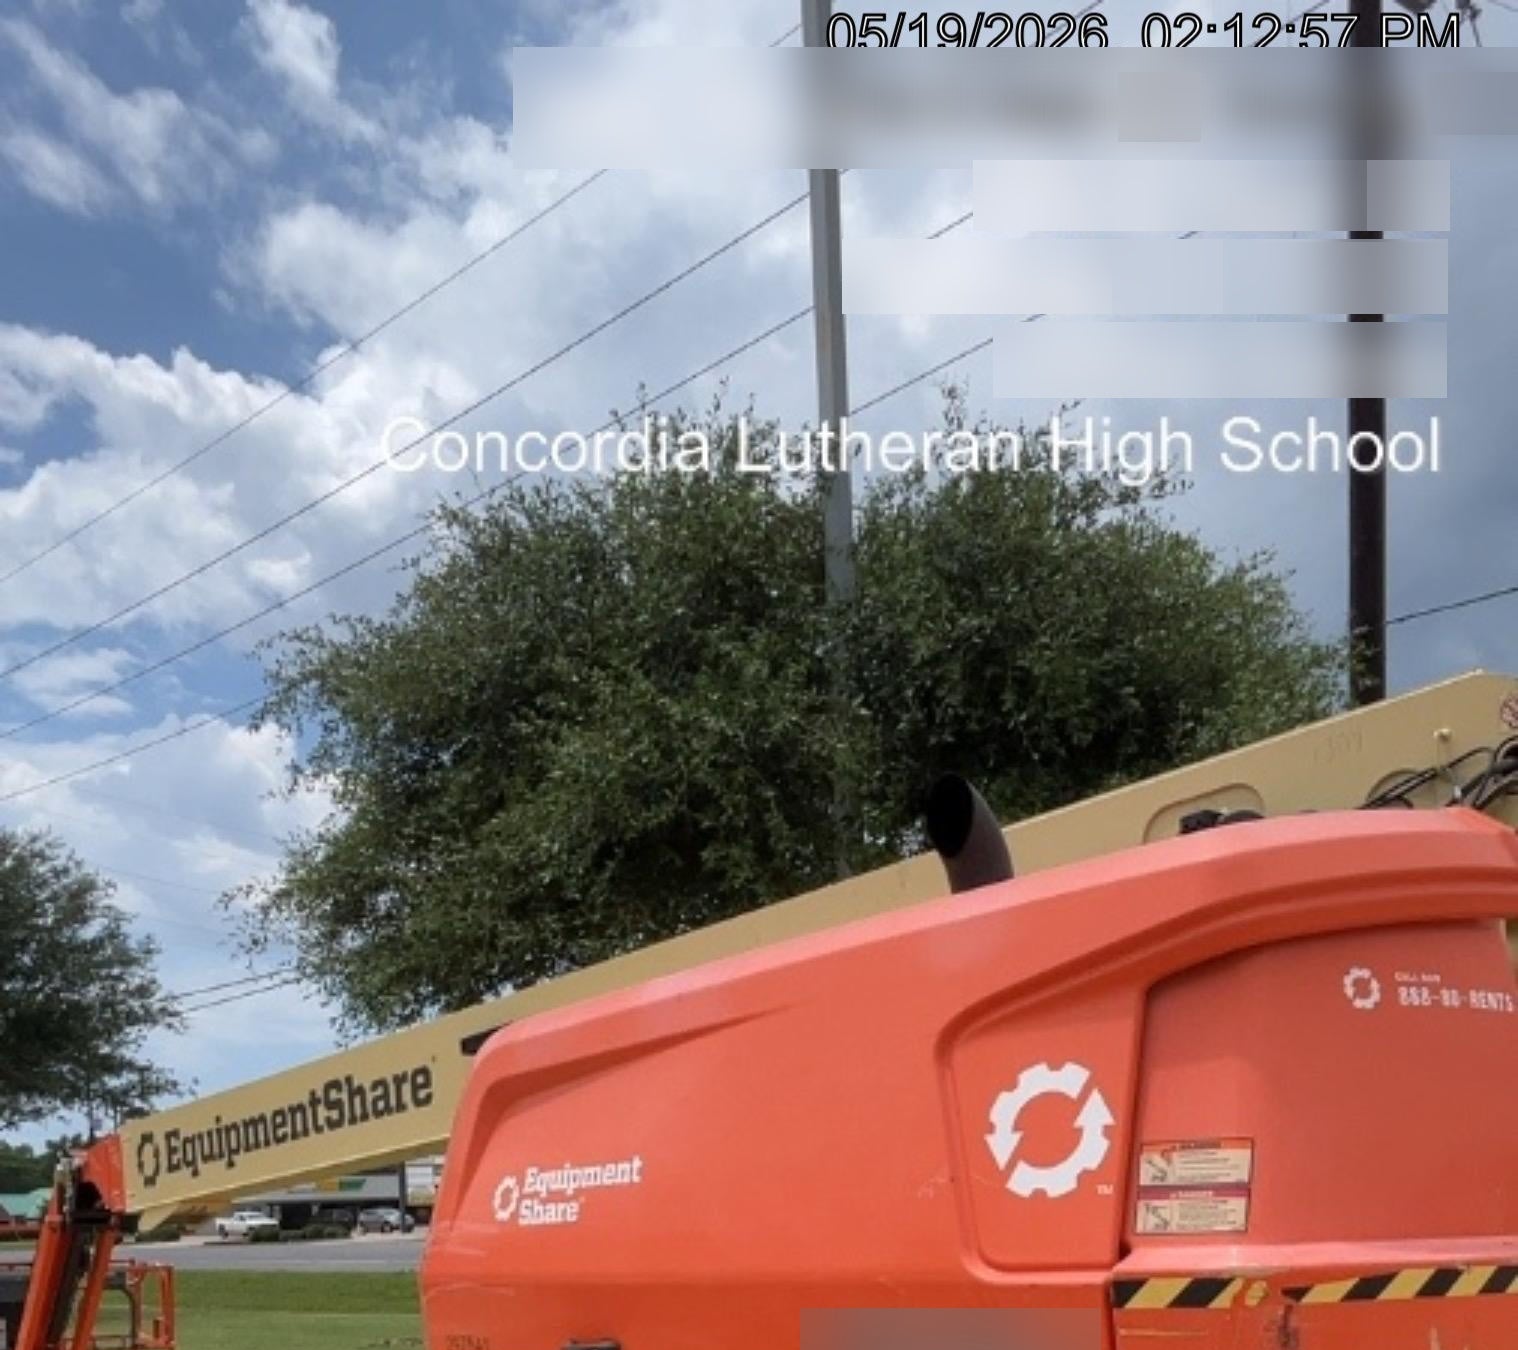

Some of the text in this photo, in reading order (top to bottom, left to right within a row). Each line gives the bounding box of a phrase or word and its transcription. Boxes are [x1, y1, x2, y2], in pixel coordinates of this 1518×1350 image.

[164, 1064, 434, 1178] EquipmentShare
[522, 1154, 643, 1198] Equipment
[518, 1199, 580, 1226] Share
